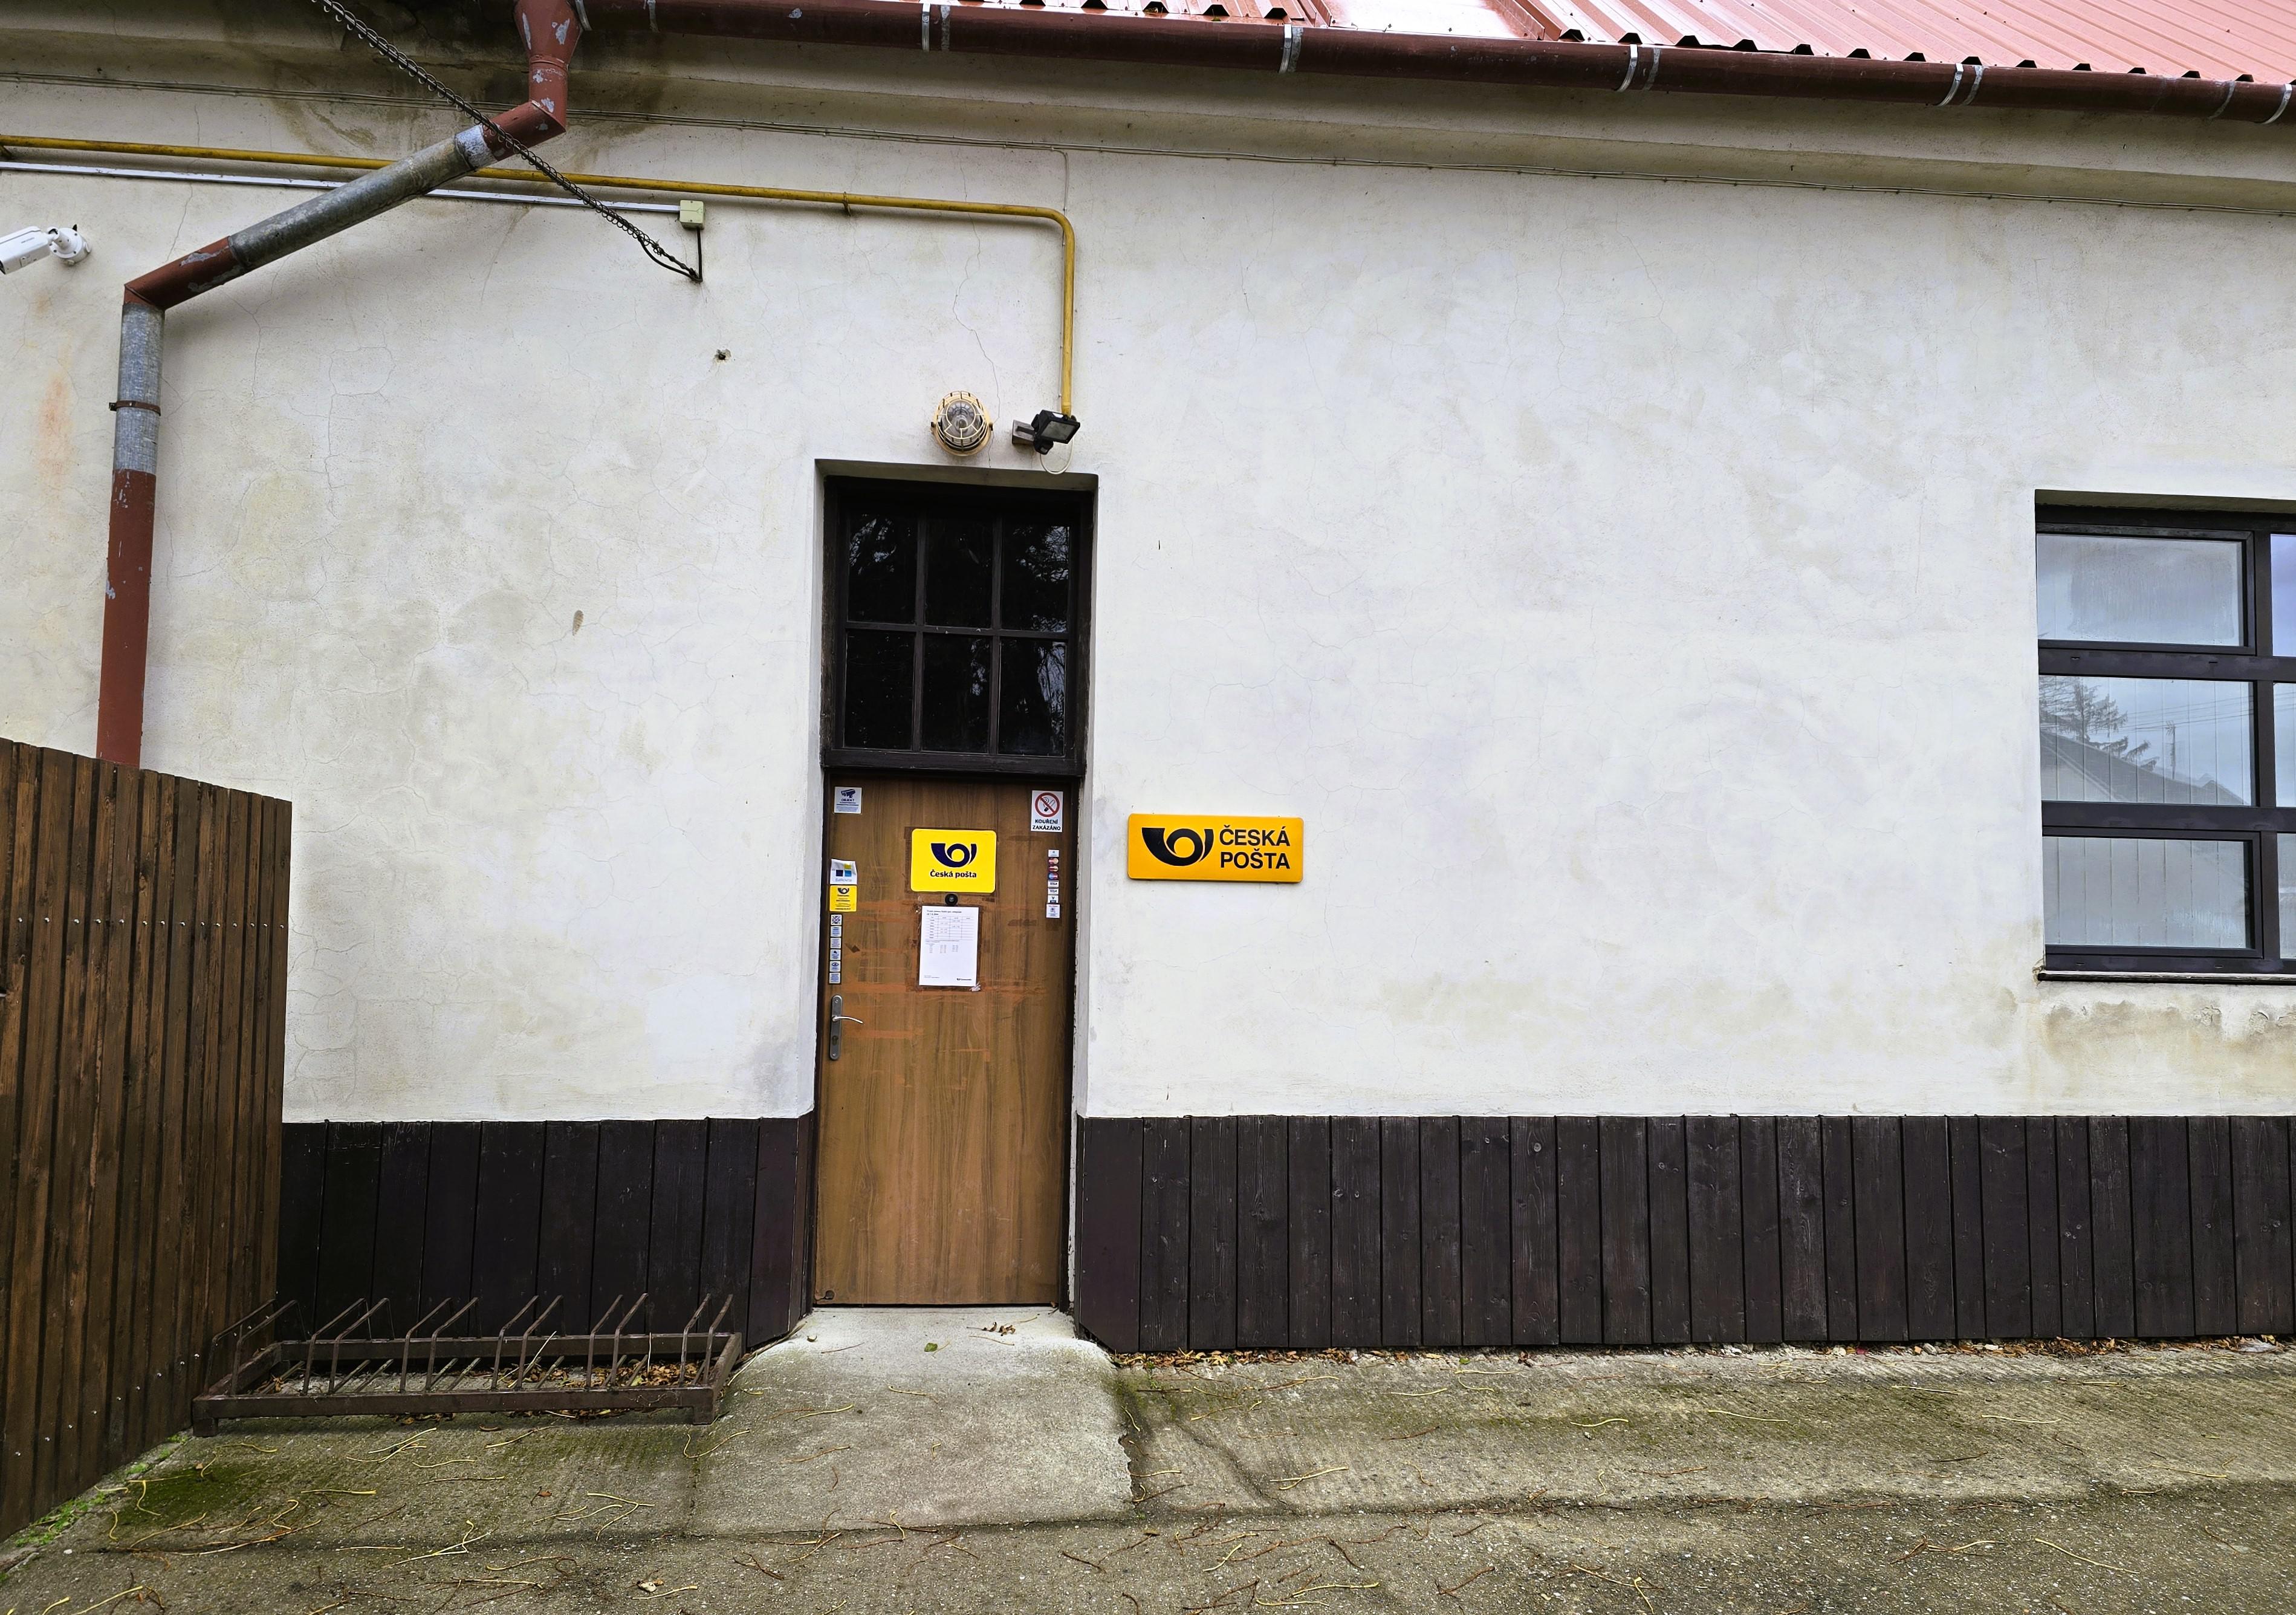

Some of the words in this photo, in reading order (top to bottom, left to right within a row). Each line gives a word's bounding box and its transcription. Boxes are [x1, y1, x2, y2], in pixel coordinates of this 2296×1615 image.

[1219, 824, 1290, 846] ČESKÁ
[1221, 848, 1290, 869] POŠTA
[930, 869, 953, 877] Česká
